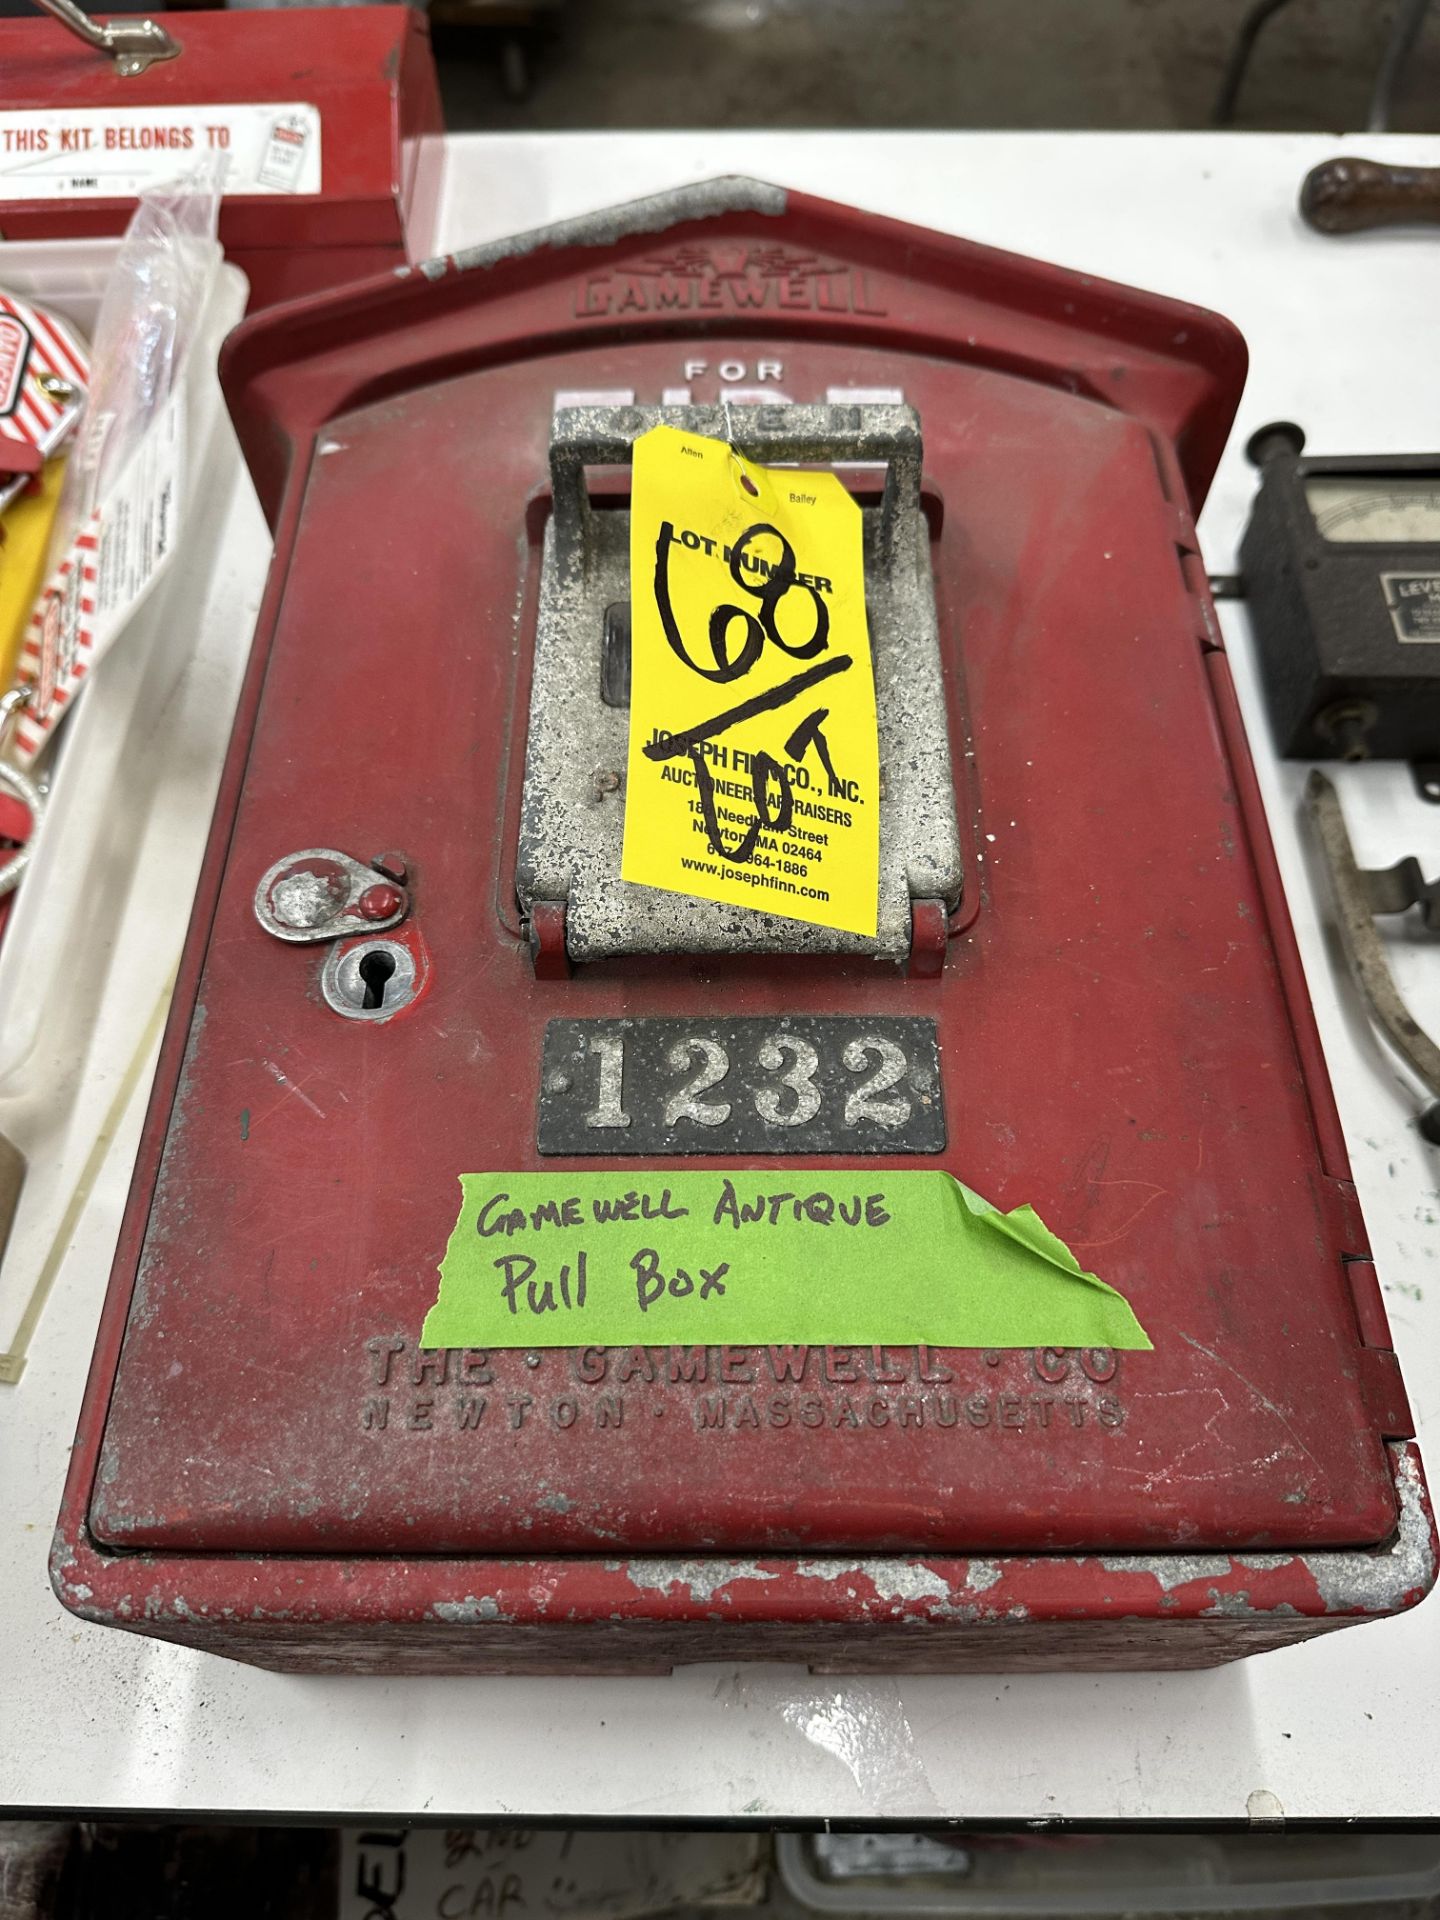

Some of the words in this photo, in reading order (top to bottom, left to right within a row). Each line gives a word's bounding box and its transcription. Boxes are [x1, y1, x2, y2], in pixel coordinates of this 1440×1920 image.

[2, 129, 48, 151] THIS
[60, 128, 93, 151] KIT
[104, 127, 194, 150] BELONGS
[206, 126, 231, 149] TO
[575, 271, 888, 317] GAMEWELL
[685, 361, 784, 382] FOR
[789, 493, 817, 506] Bailey
[723, 545, 834, 594] NUMER
[828, 774, 866, 805] INC.
[766, 793, 853, 828] APRAISERS
[755, 834, 779, 852] MA
[782, 842, 823, 863] 02464
[788, 825, 829, 846] Street
[680, 857, 830, 903] www.josephfinn.com
[587, 1036, 912, 1129] 1232
[713, 1178, 892, 1230] ANTIQUE
[493, 1250, 588, 1315] Pull
[629, 1247, 730, 1312] Box
[368, 1336, 494, 1386] THE
[576, 1345, 952, 1385] GAMEWELL
[1034, 1344, 1121, 1384] CO
[362, 1396, 626, 1431] NEWTON
[699, 1395, 1125, 1429] MASSACHUSETTS
